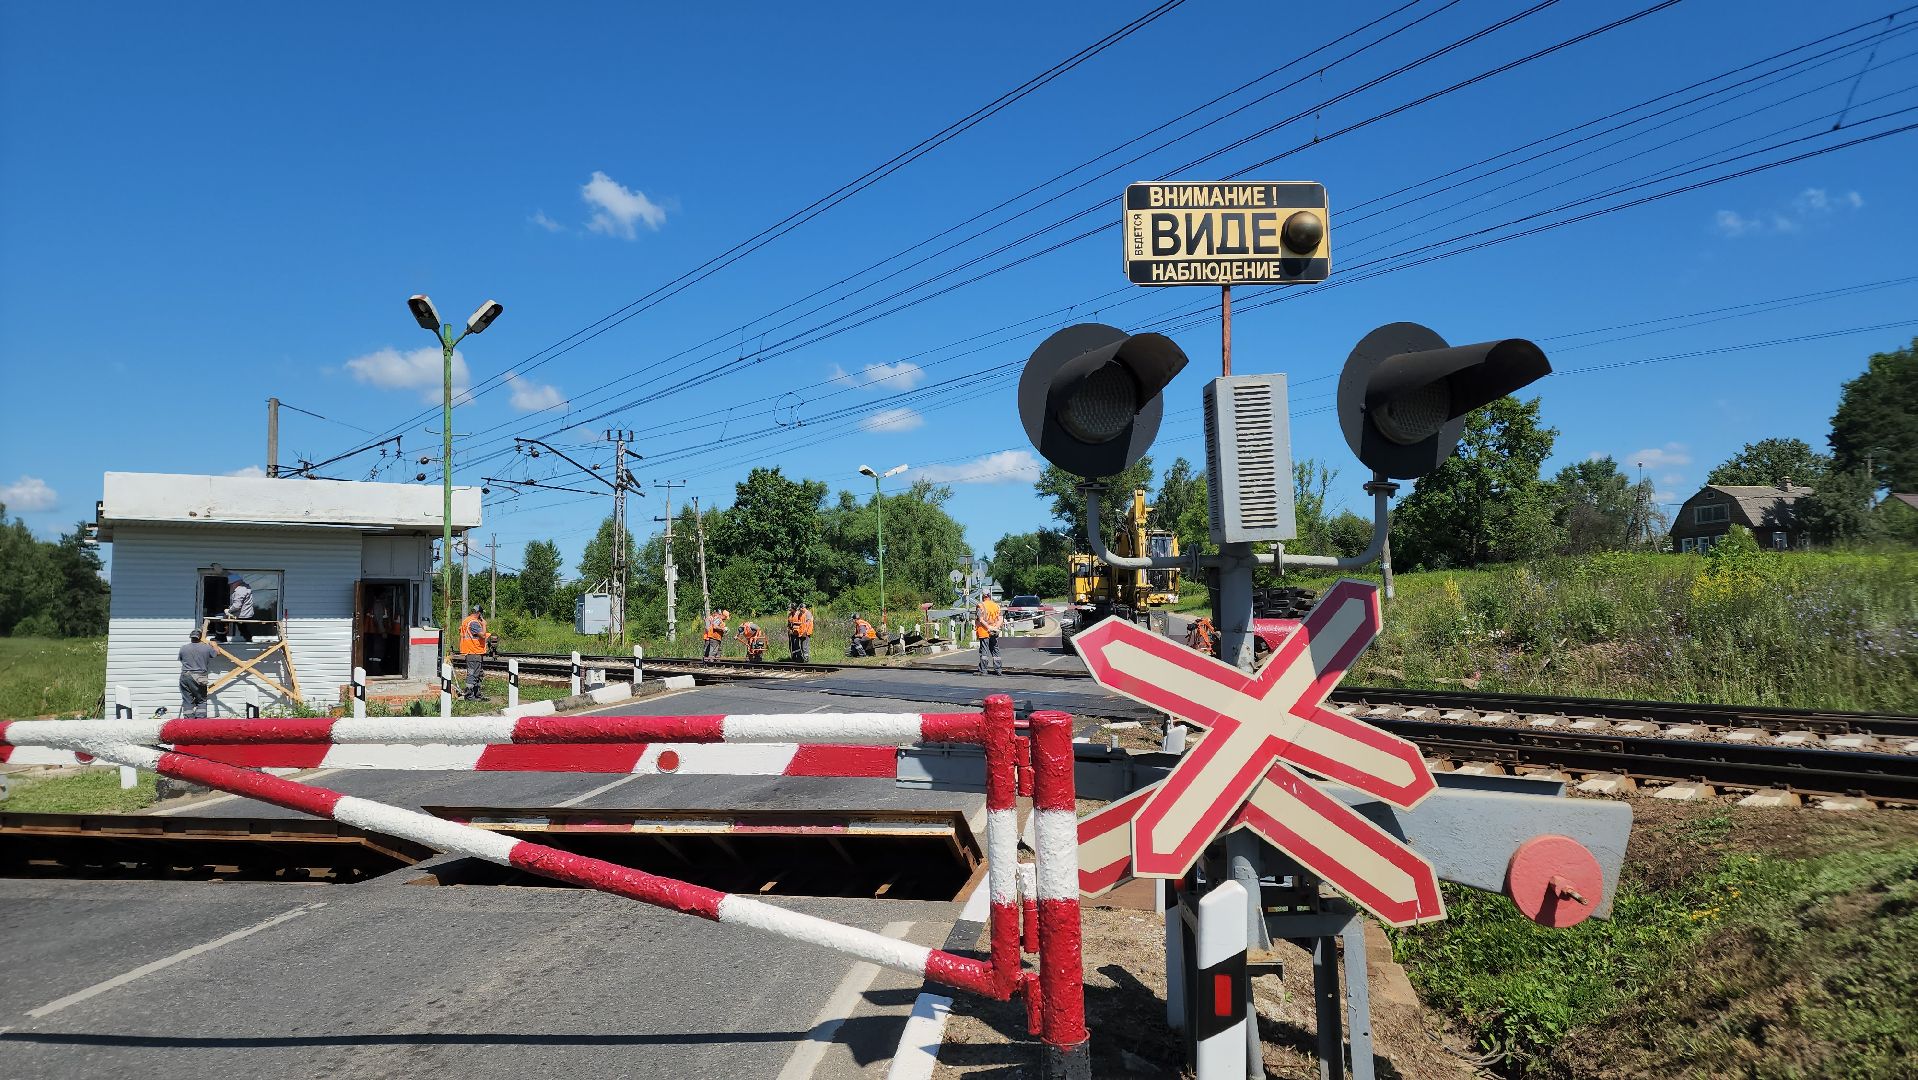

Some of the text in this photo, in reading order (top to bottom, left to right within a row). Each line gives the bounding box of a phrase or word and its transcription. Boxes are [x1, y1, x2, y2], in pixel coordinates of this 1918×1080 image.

[1150, 186, 1265, 207] ВНИМАНИЕ
[1134, 213, 1144, 256] ВЕДЕТСЯ
[1152, 261, 1281, 282] НАБЛЮДЕНИЕ
